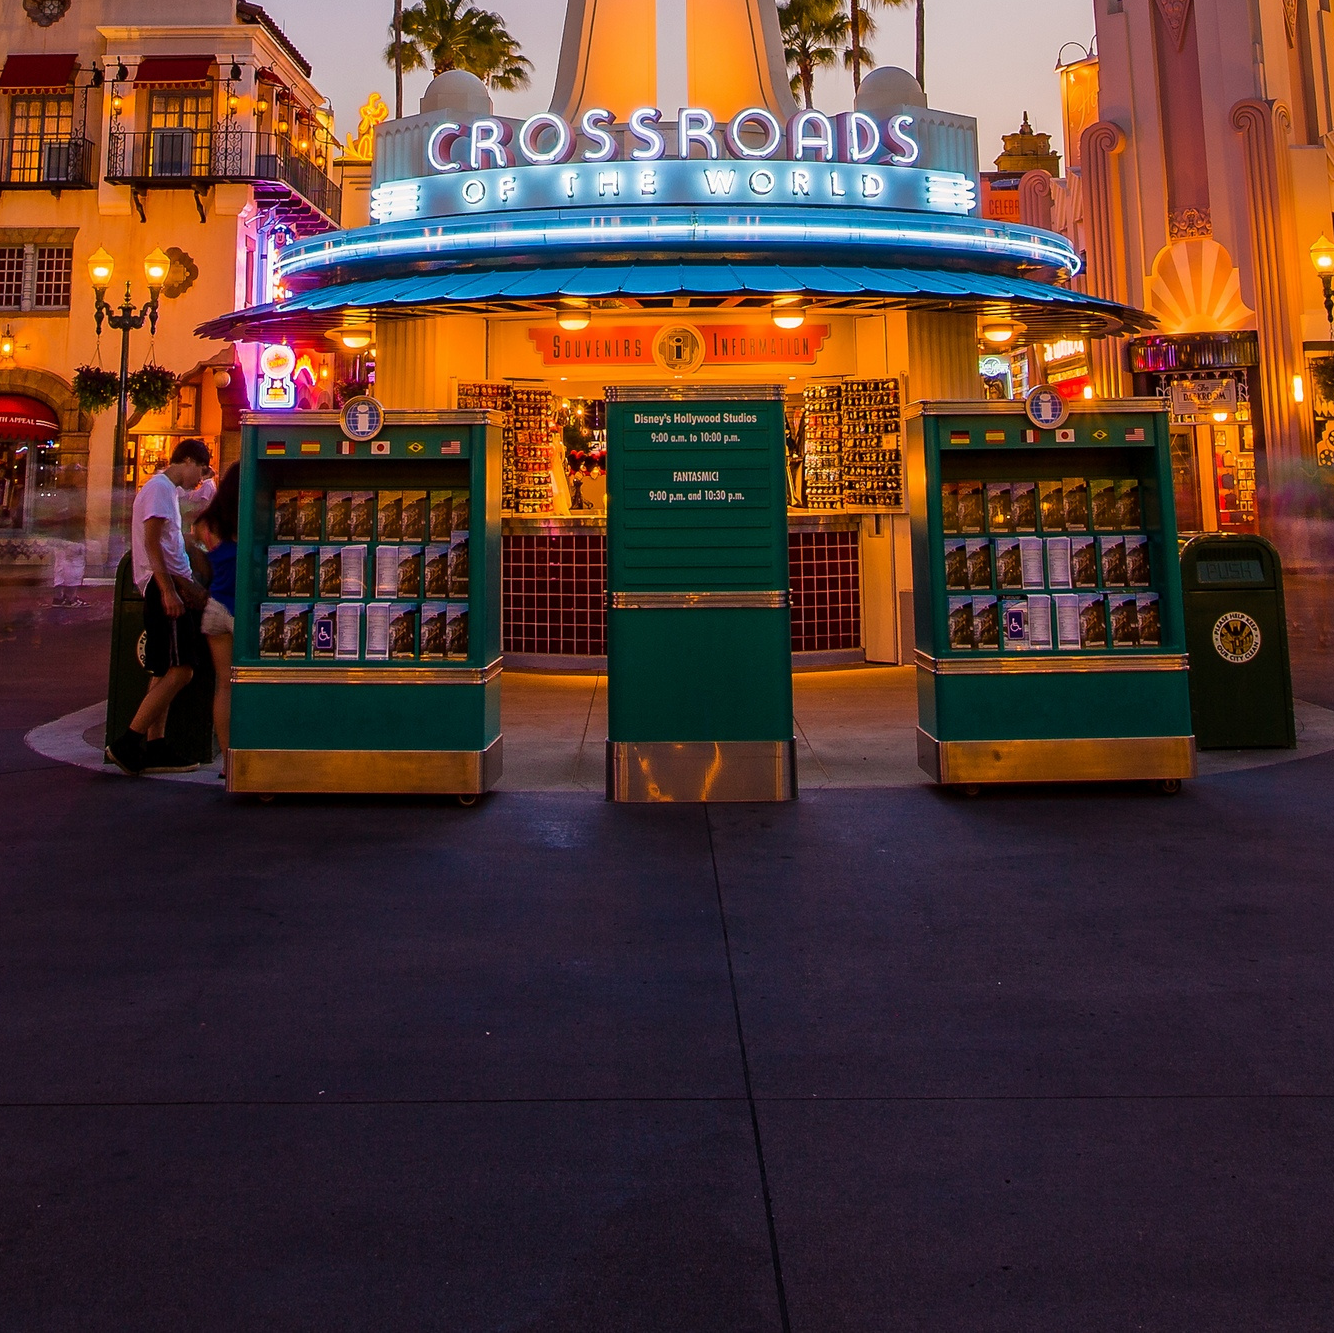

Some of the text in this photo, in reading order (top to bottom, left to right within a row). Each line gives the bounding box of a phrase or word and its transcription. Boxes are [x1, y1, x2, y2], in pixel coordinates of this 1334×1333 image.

[427, 107, 919, 173] CROSSROADS
[461, 169, 885, 204] OF THE WORLD
[552, 333, 809, 359] SOUVENIRS INFORMATION
[9, 417, 35, 425] APPEAL
[634, 413, 757, 425] Disney's Hollywood Studios
[650, 432, 741, 444] 9:00 a.m. to 10:00 p.m.
[672, 471, 719, 482] FANTASMIC!
[649, 490, 745, 503] 9:00 p.m. and 10:30 p.m.
[1207, 561, 1254, 579] PUSH
[1213, 612, 1259, 636] PLEASE HELP KEEP
[1216, 644, 1229, 658] OUR
[1244, 641, 1260, 659] CLEAN
